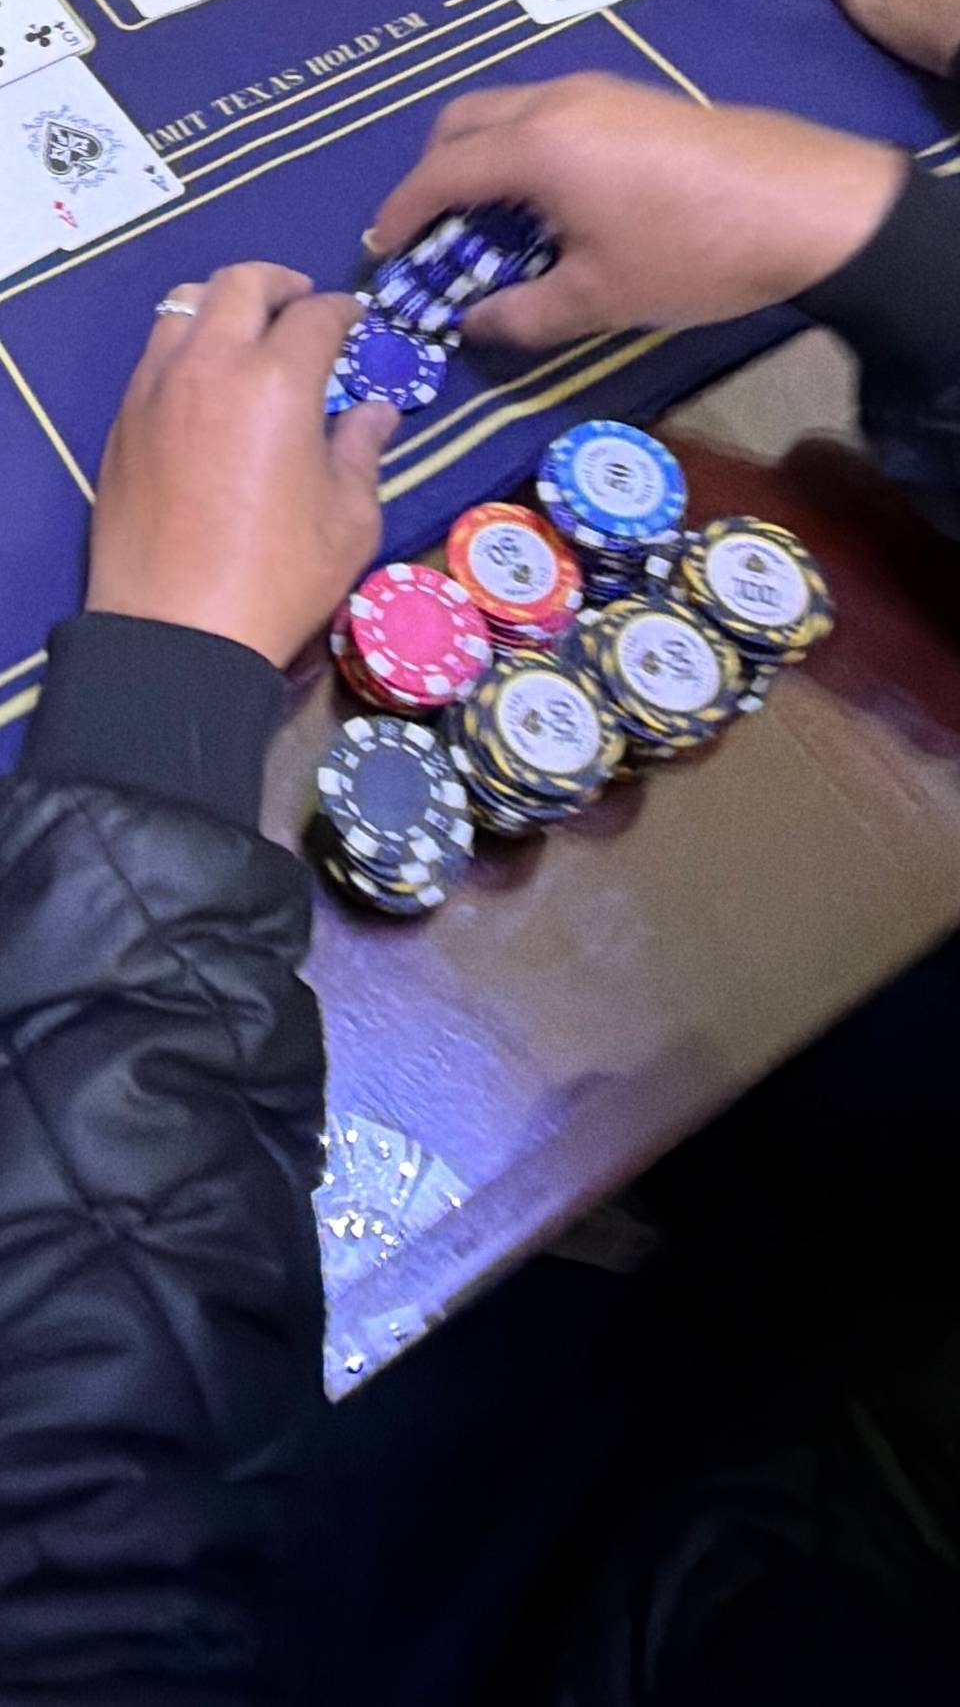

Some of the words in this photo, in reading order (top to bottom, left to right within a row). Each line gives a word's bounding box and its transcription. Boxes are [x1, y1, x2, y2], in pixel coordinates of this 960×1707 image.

[146, 110, 208, 151] IMIT
[210, 68, 305, 116] TEXAS
[304, 12, 429, 76] HOLD'EM
